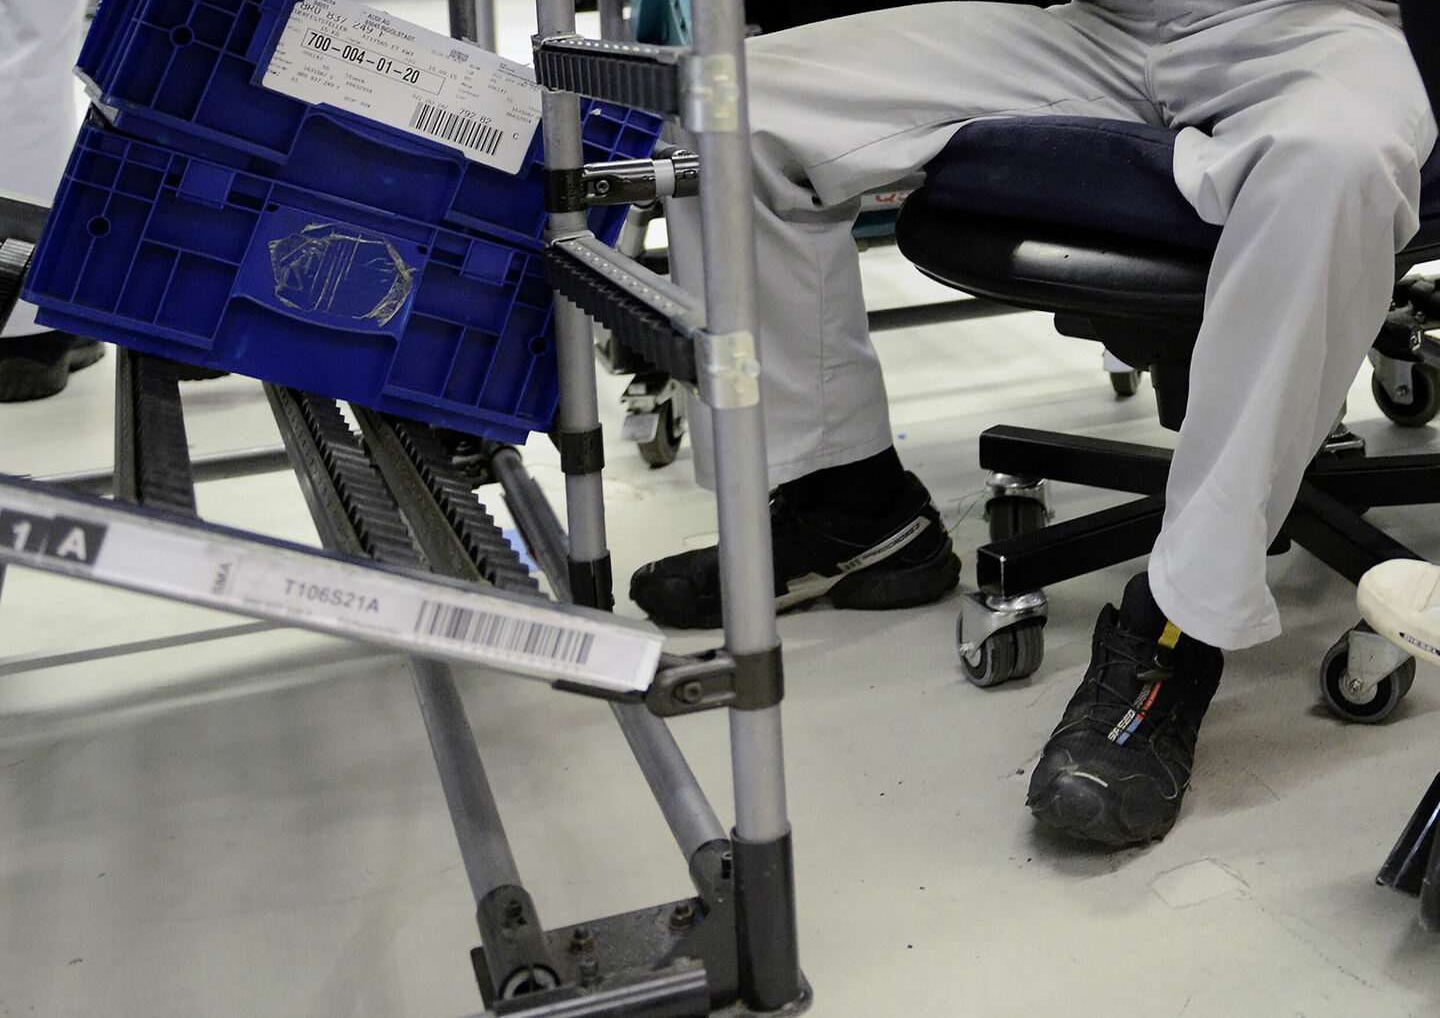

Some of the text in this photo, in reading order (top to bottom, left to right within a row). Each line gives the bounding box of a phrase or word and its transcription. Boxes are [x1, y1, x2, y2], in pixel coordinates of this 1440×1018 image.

[307, 31, 421, 85] 700-004-01-20
[10, 522, 89, 562] 1 A
[284, 577, 380, 615] T106S21A
